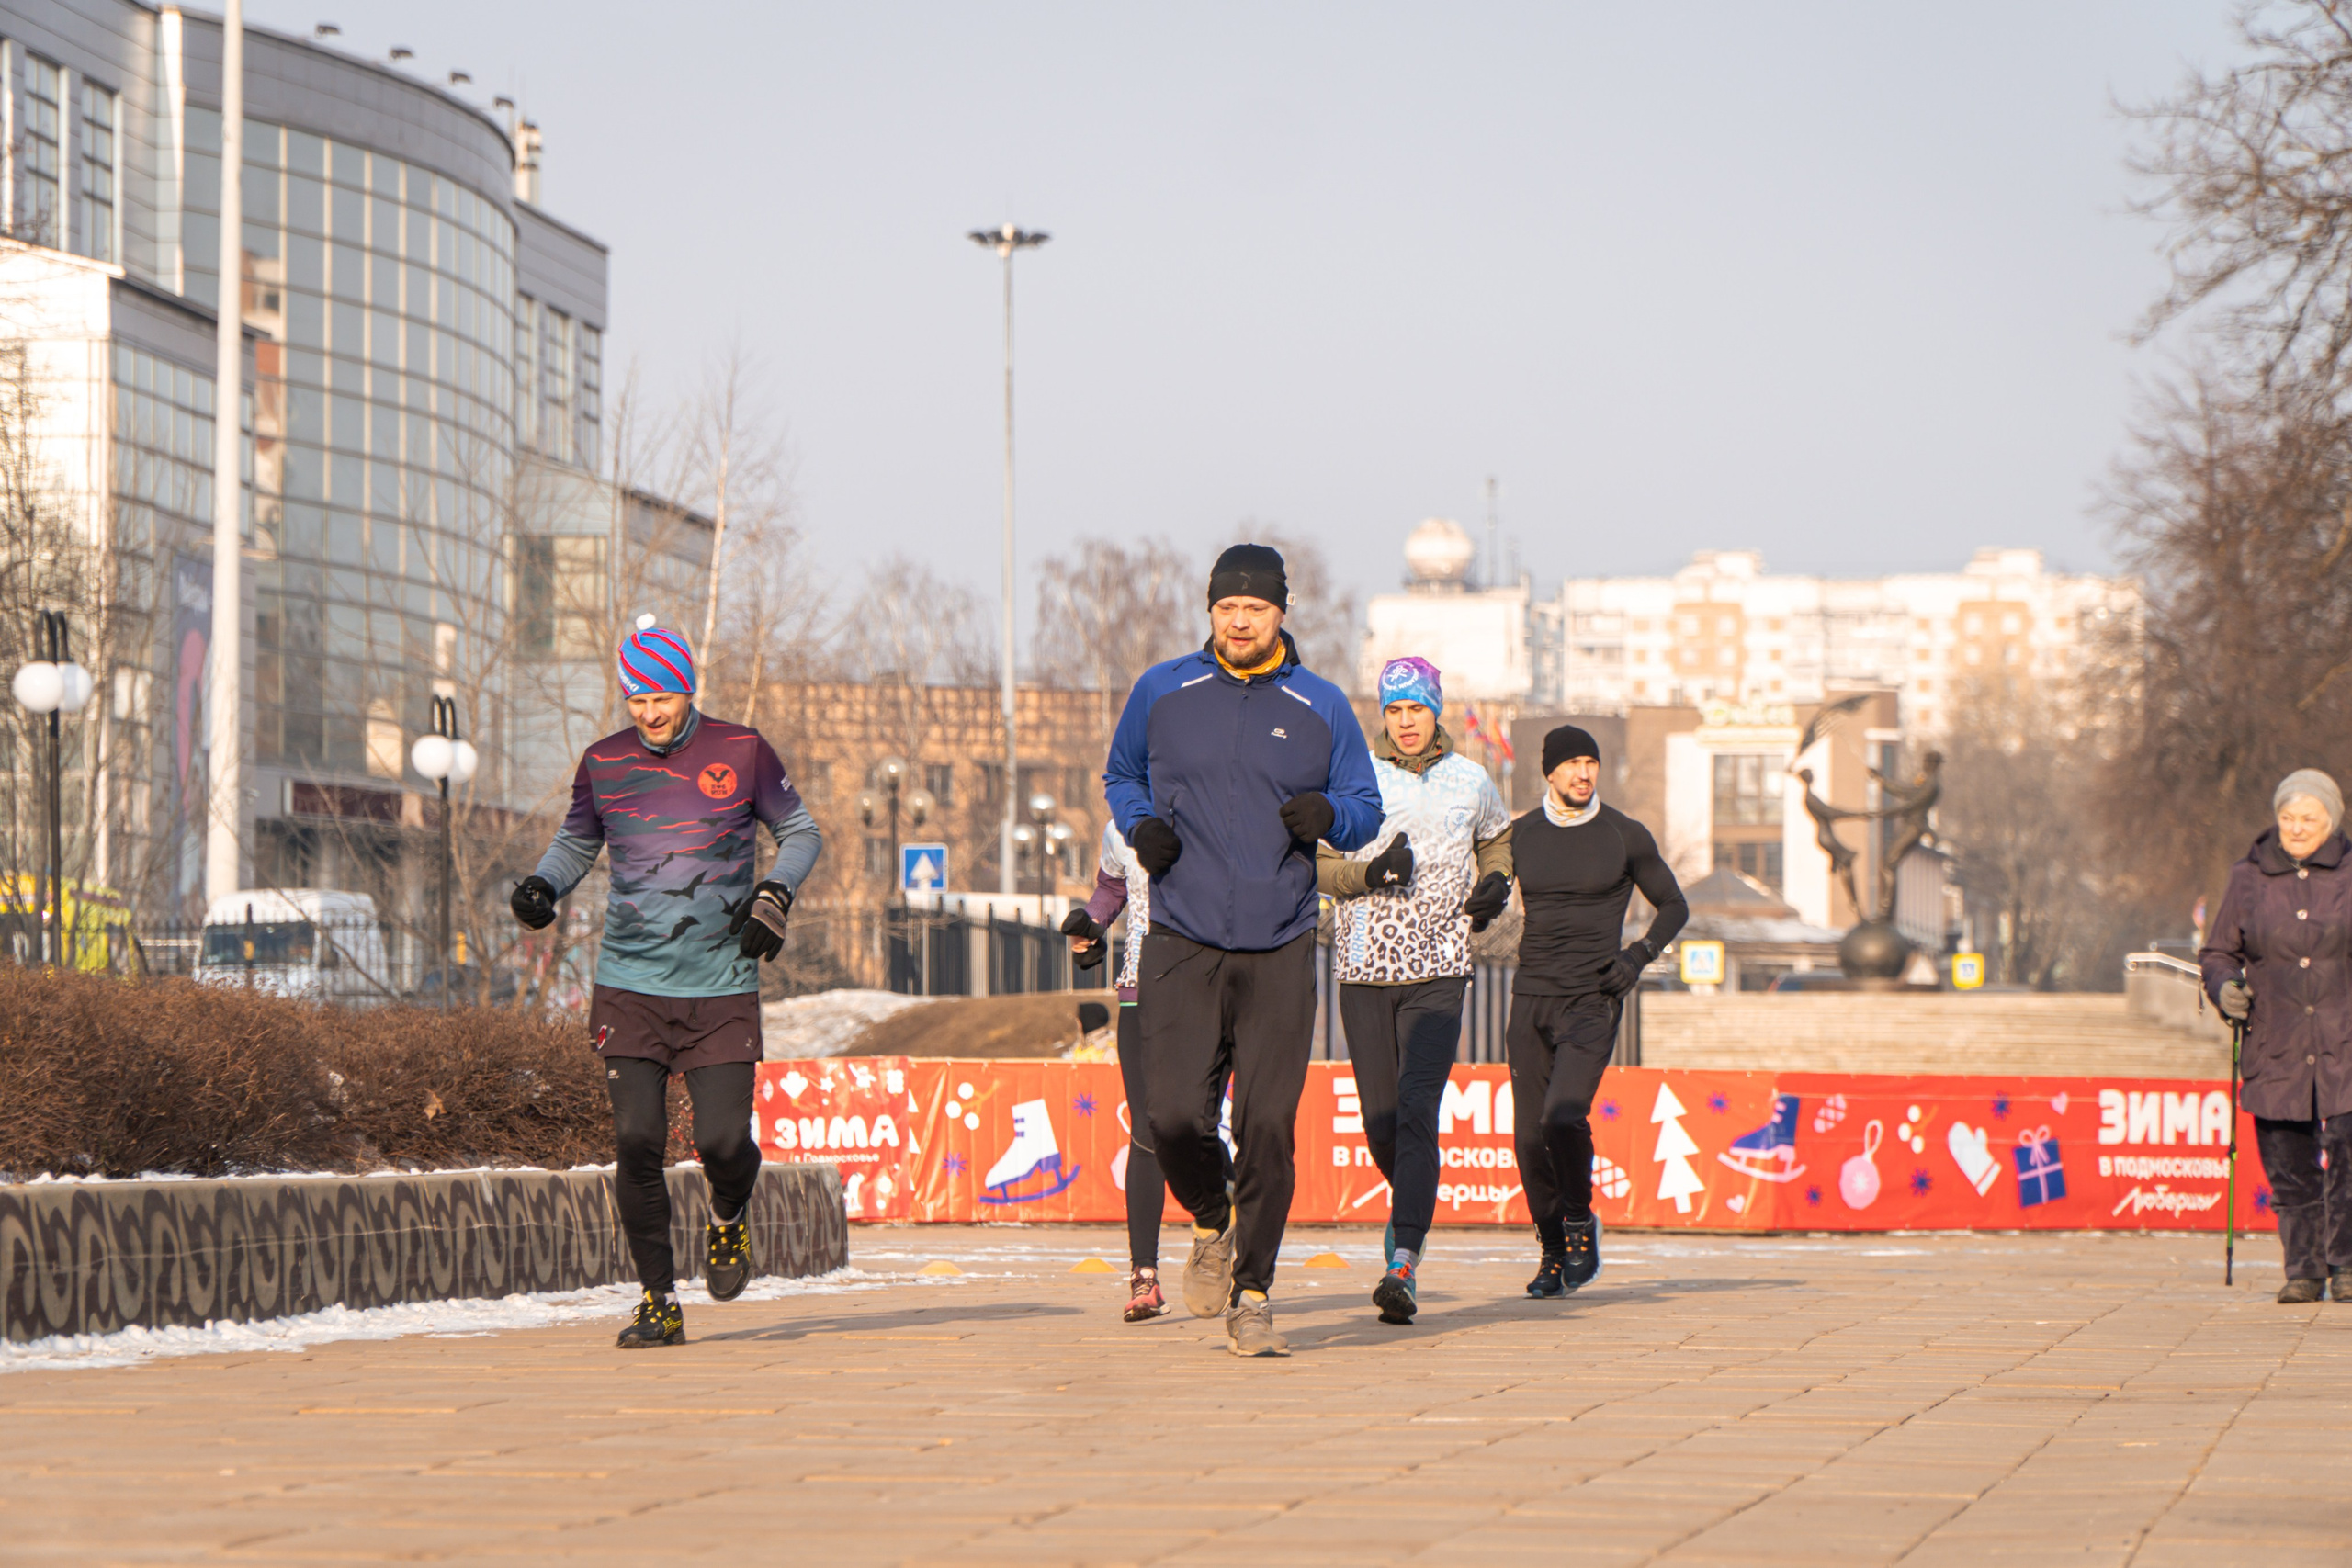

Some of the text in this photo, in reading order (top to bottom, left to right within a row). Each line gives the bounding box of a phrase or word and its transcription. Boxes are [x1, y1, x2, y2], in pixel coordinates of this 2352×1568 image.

[775, 1114, 900, 1150] ЗИМА
[2098, 1089, 2233, 1146] ЗИМА
[2114, 1156, 2231, 1180] ПОДМОСКОВЬЕ
[2111, 1184, 2222, 1219] Люберцы
